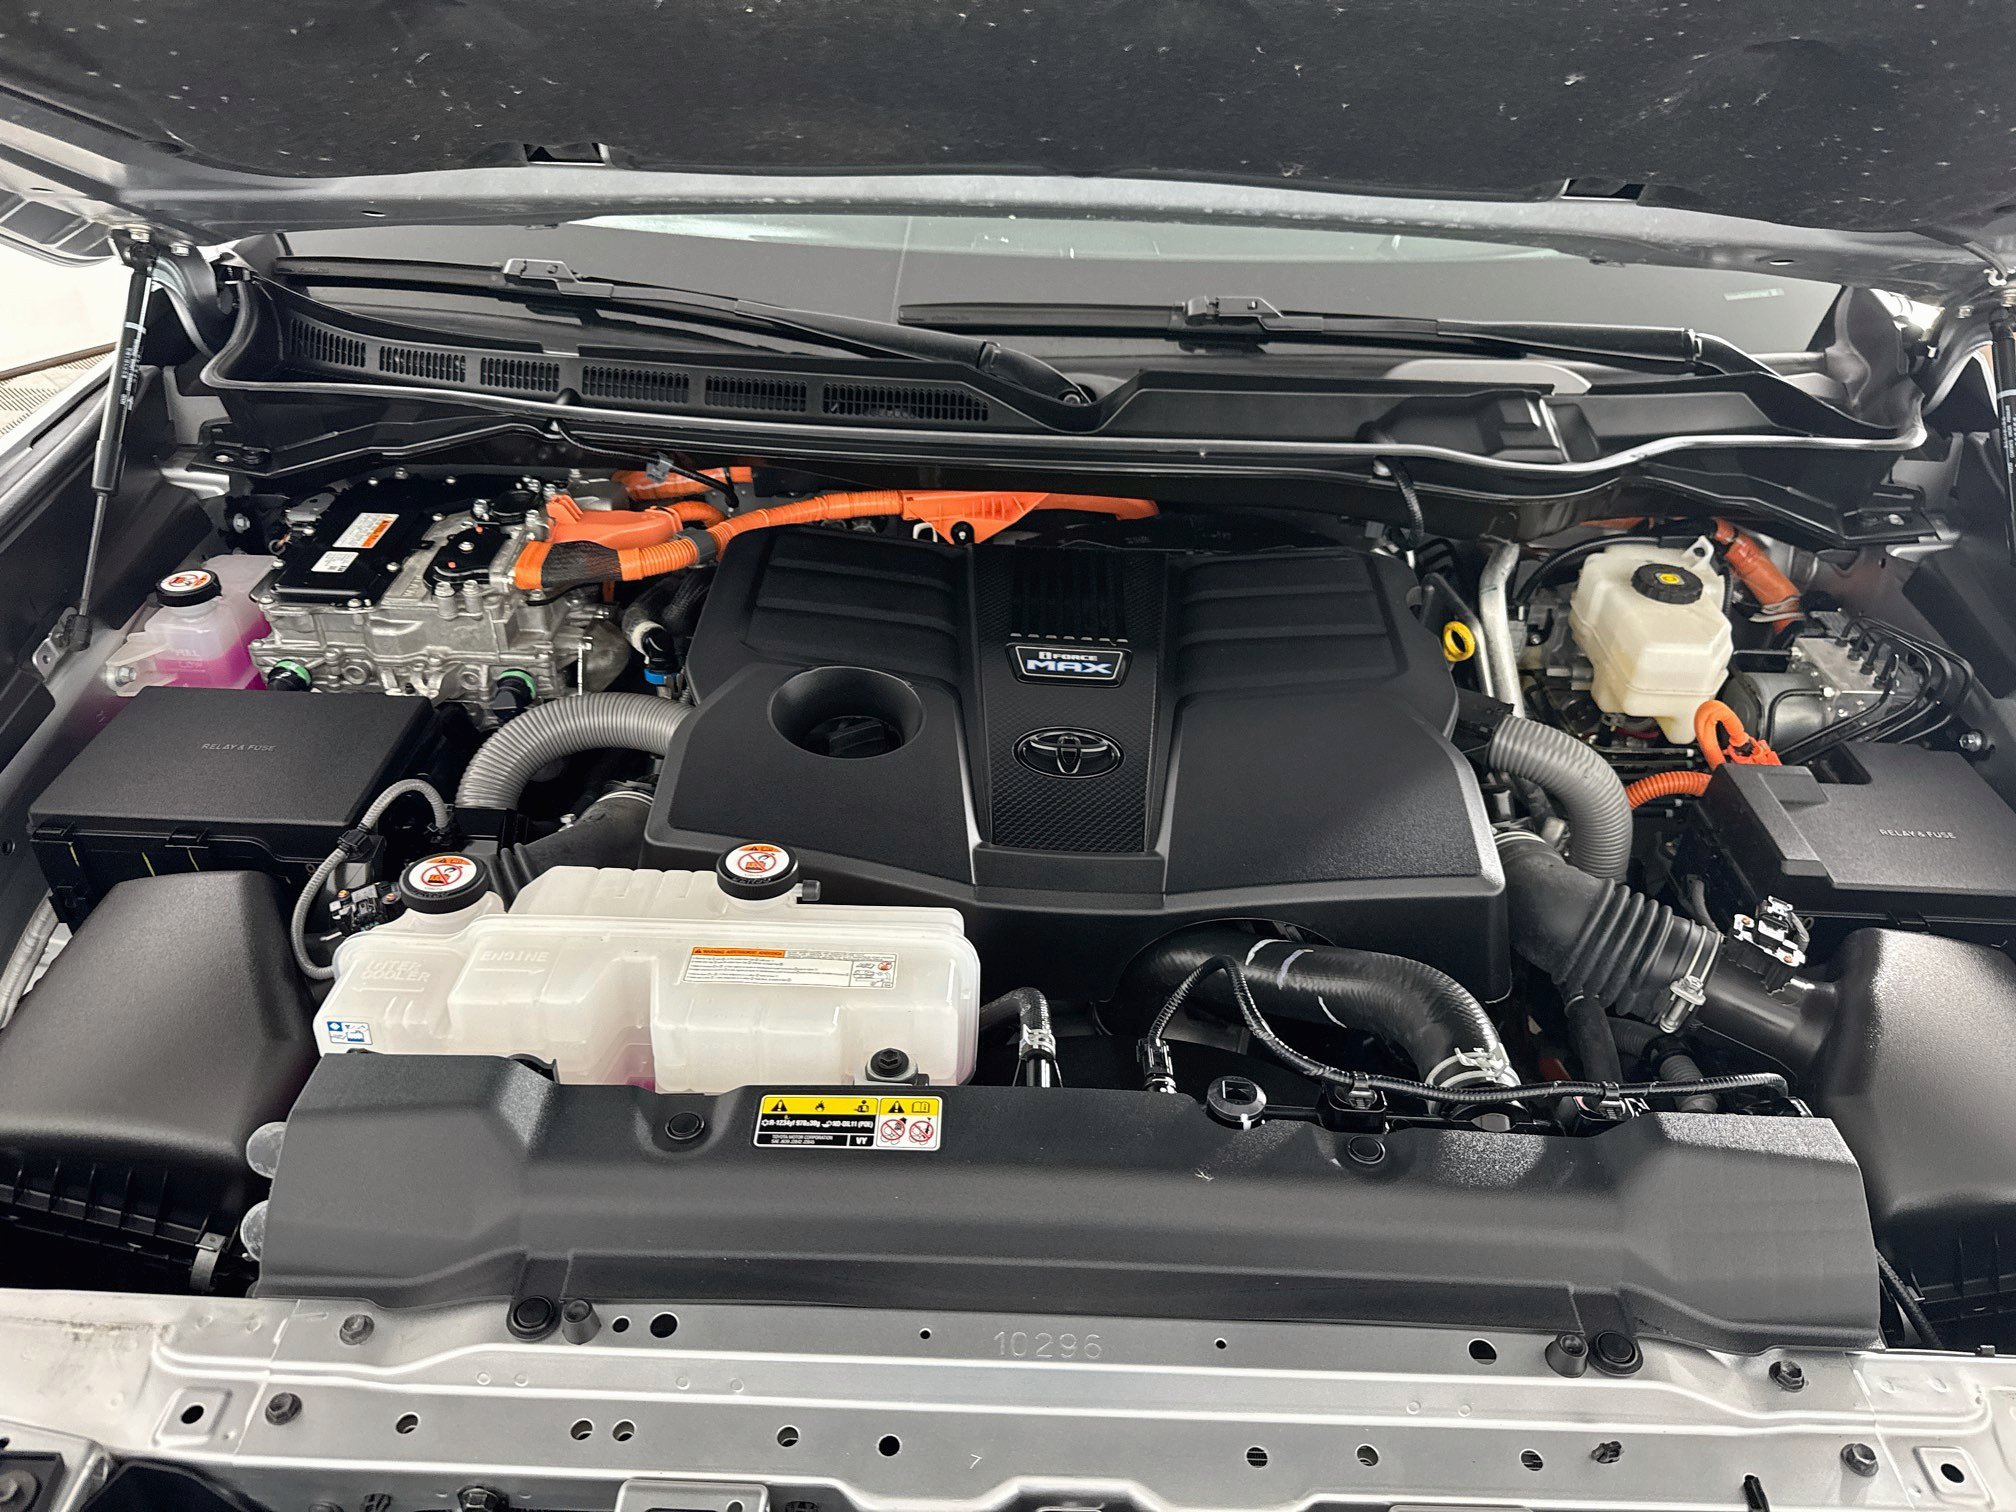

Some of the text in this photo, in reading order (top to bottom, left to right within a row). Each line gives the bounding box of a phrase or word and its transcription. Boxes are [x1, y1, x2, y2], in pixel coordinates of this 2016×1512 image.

[1026, 659, 1112, 674] MAX
[247, 744, 276, 752] FUSE
[1879, 828, 1957, 839] RELAY & FUSE
[479, 950, 550, 962] ENGINE
[856, 1136, 868, 1144] VY
[993, 1331, 1102, 1358] 10296
